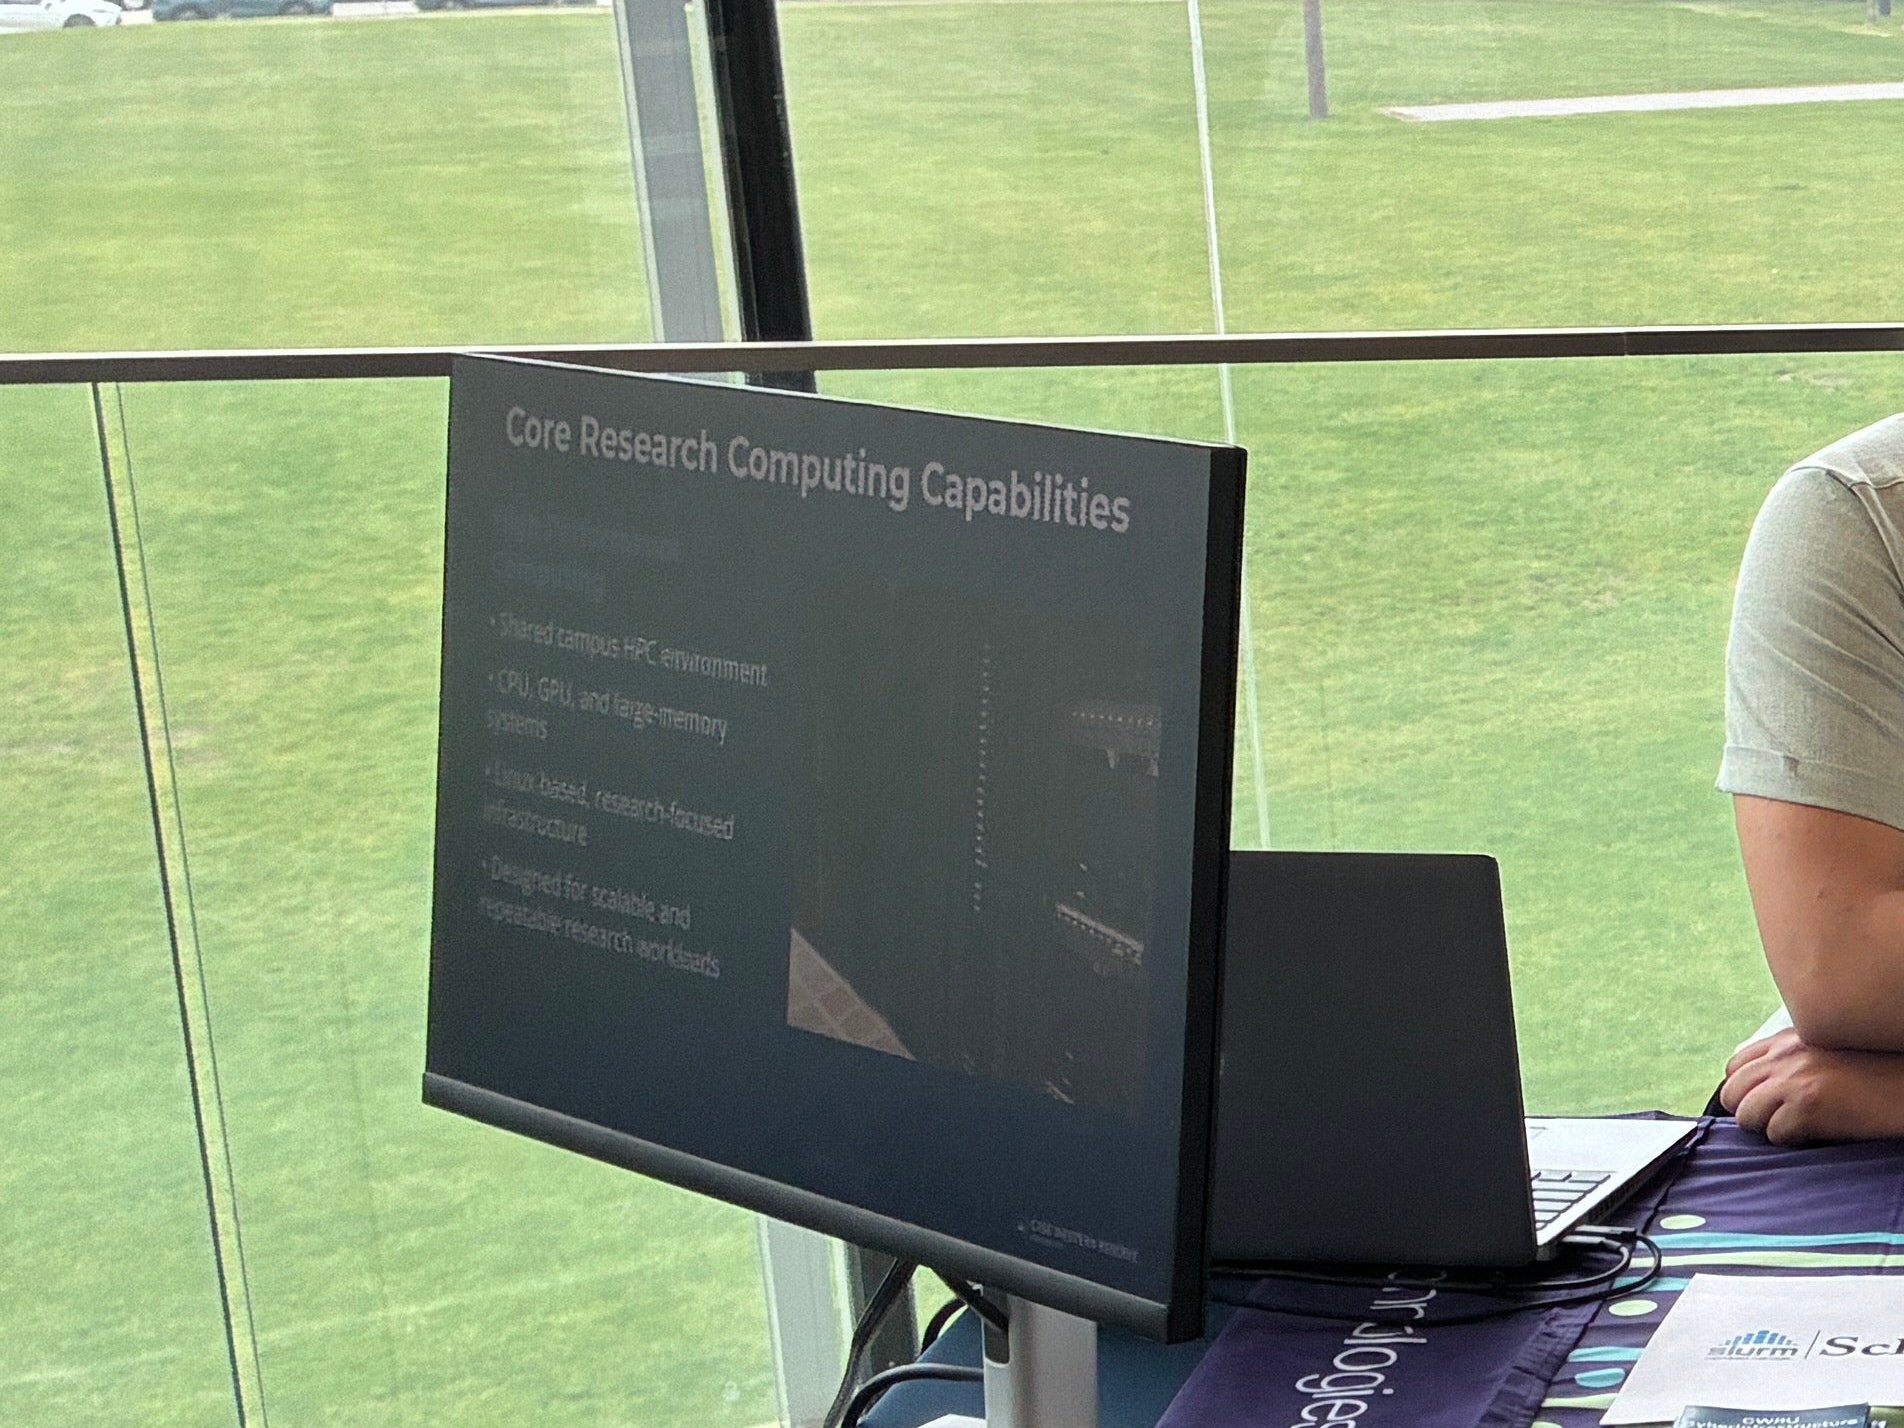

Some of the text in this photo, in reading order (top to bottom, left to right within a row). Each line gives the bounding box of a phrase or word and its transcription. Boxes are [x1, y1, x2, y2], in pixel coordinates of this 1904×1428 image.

[505, 405, 1132, 534] Core Research Computing Capabilities
[660, 644, 769, 687] environment
[579, 689, 610, 715] and
[659, 902, 691, 930] and
